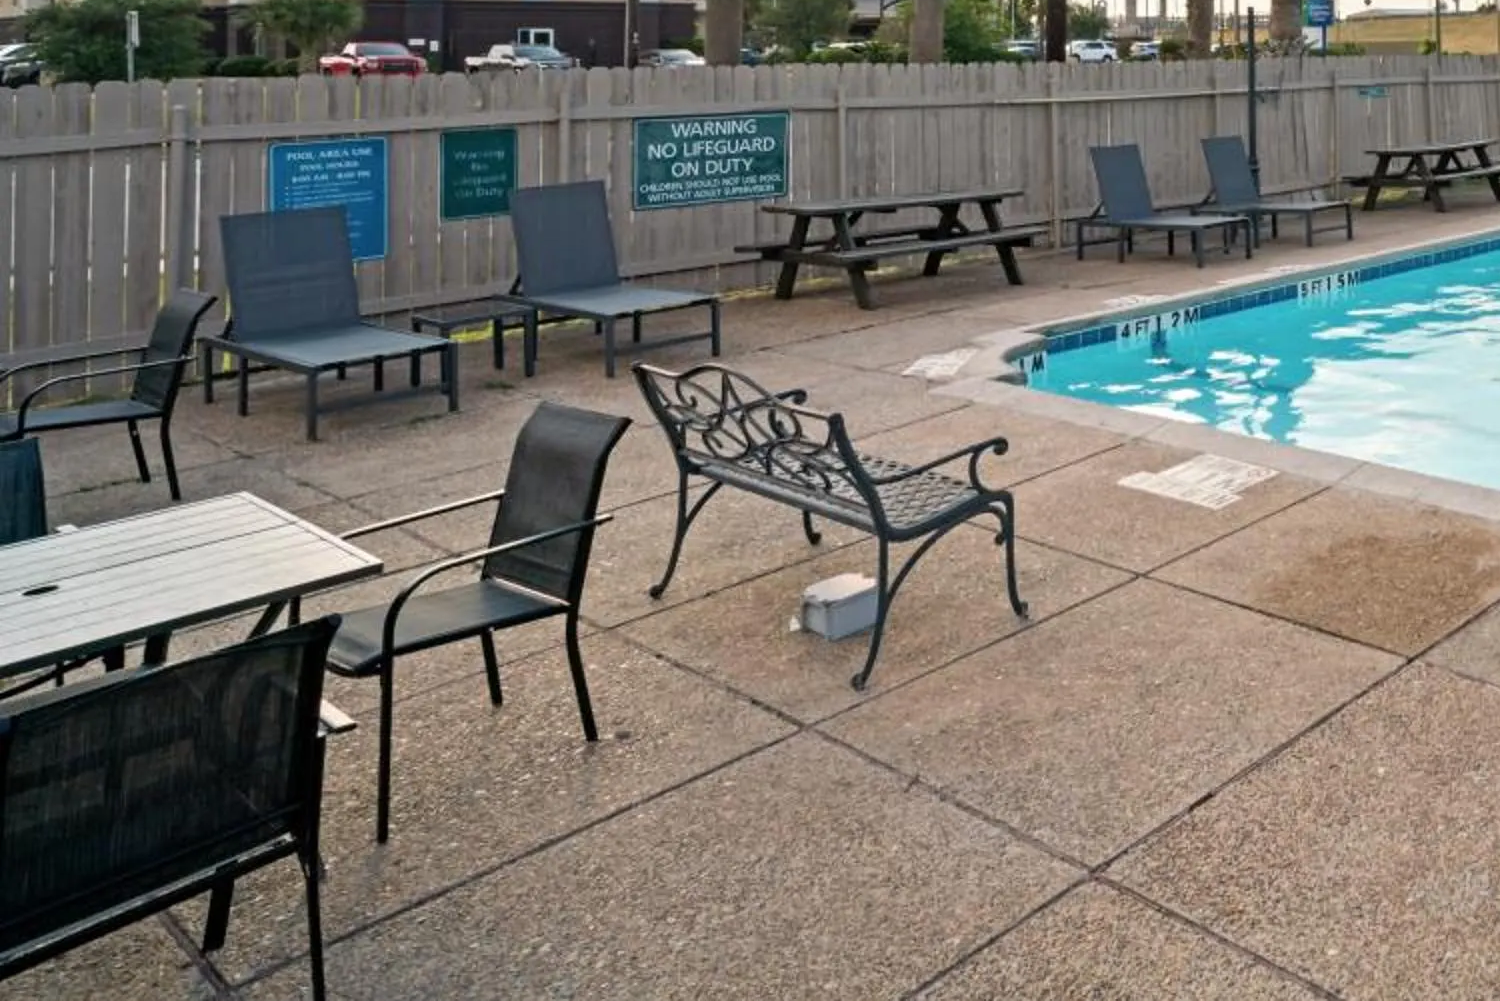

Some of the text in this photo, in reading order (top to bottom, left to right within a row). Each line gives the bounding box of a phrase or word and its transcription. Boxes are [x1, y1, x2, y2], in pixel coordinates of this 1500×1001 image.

[671, 119, 757, 138] WARNING
[647, 136, 776, 160] NO LIFEGUARD
[671, 157, 754, 178] ON DUTY
[639, 174, 782, 193] CHILDREN SHOULD NOT USE POOL
[648, 184, 775, 204] WITHOUT ADULT SUPERVISION
